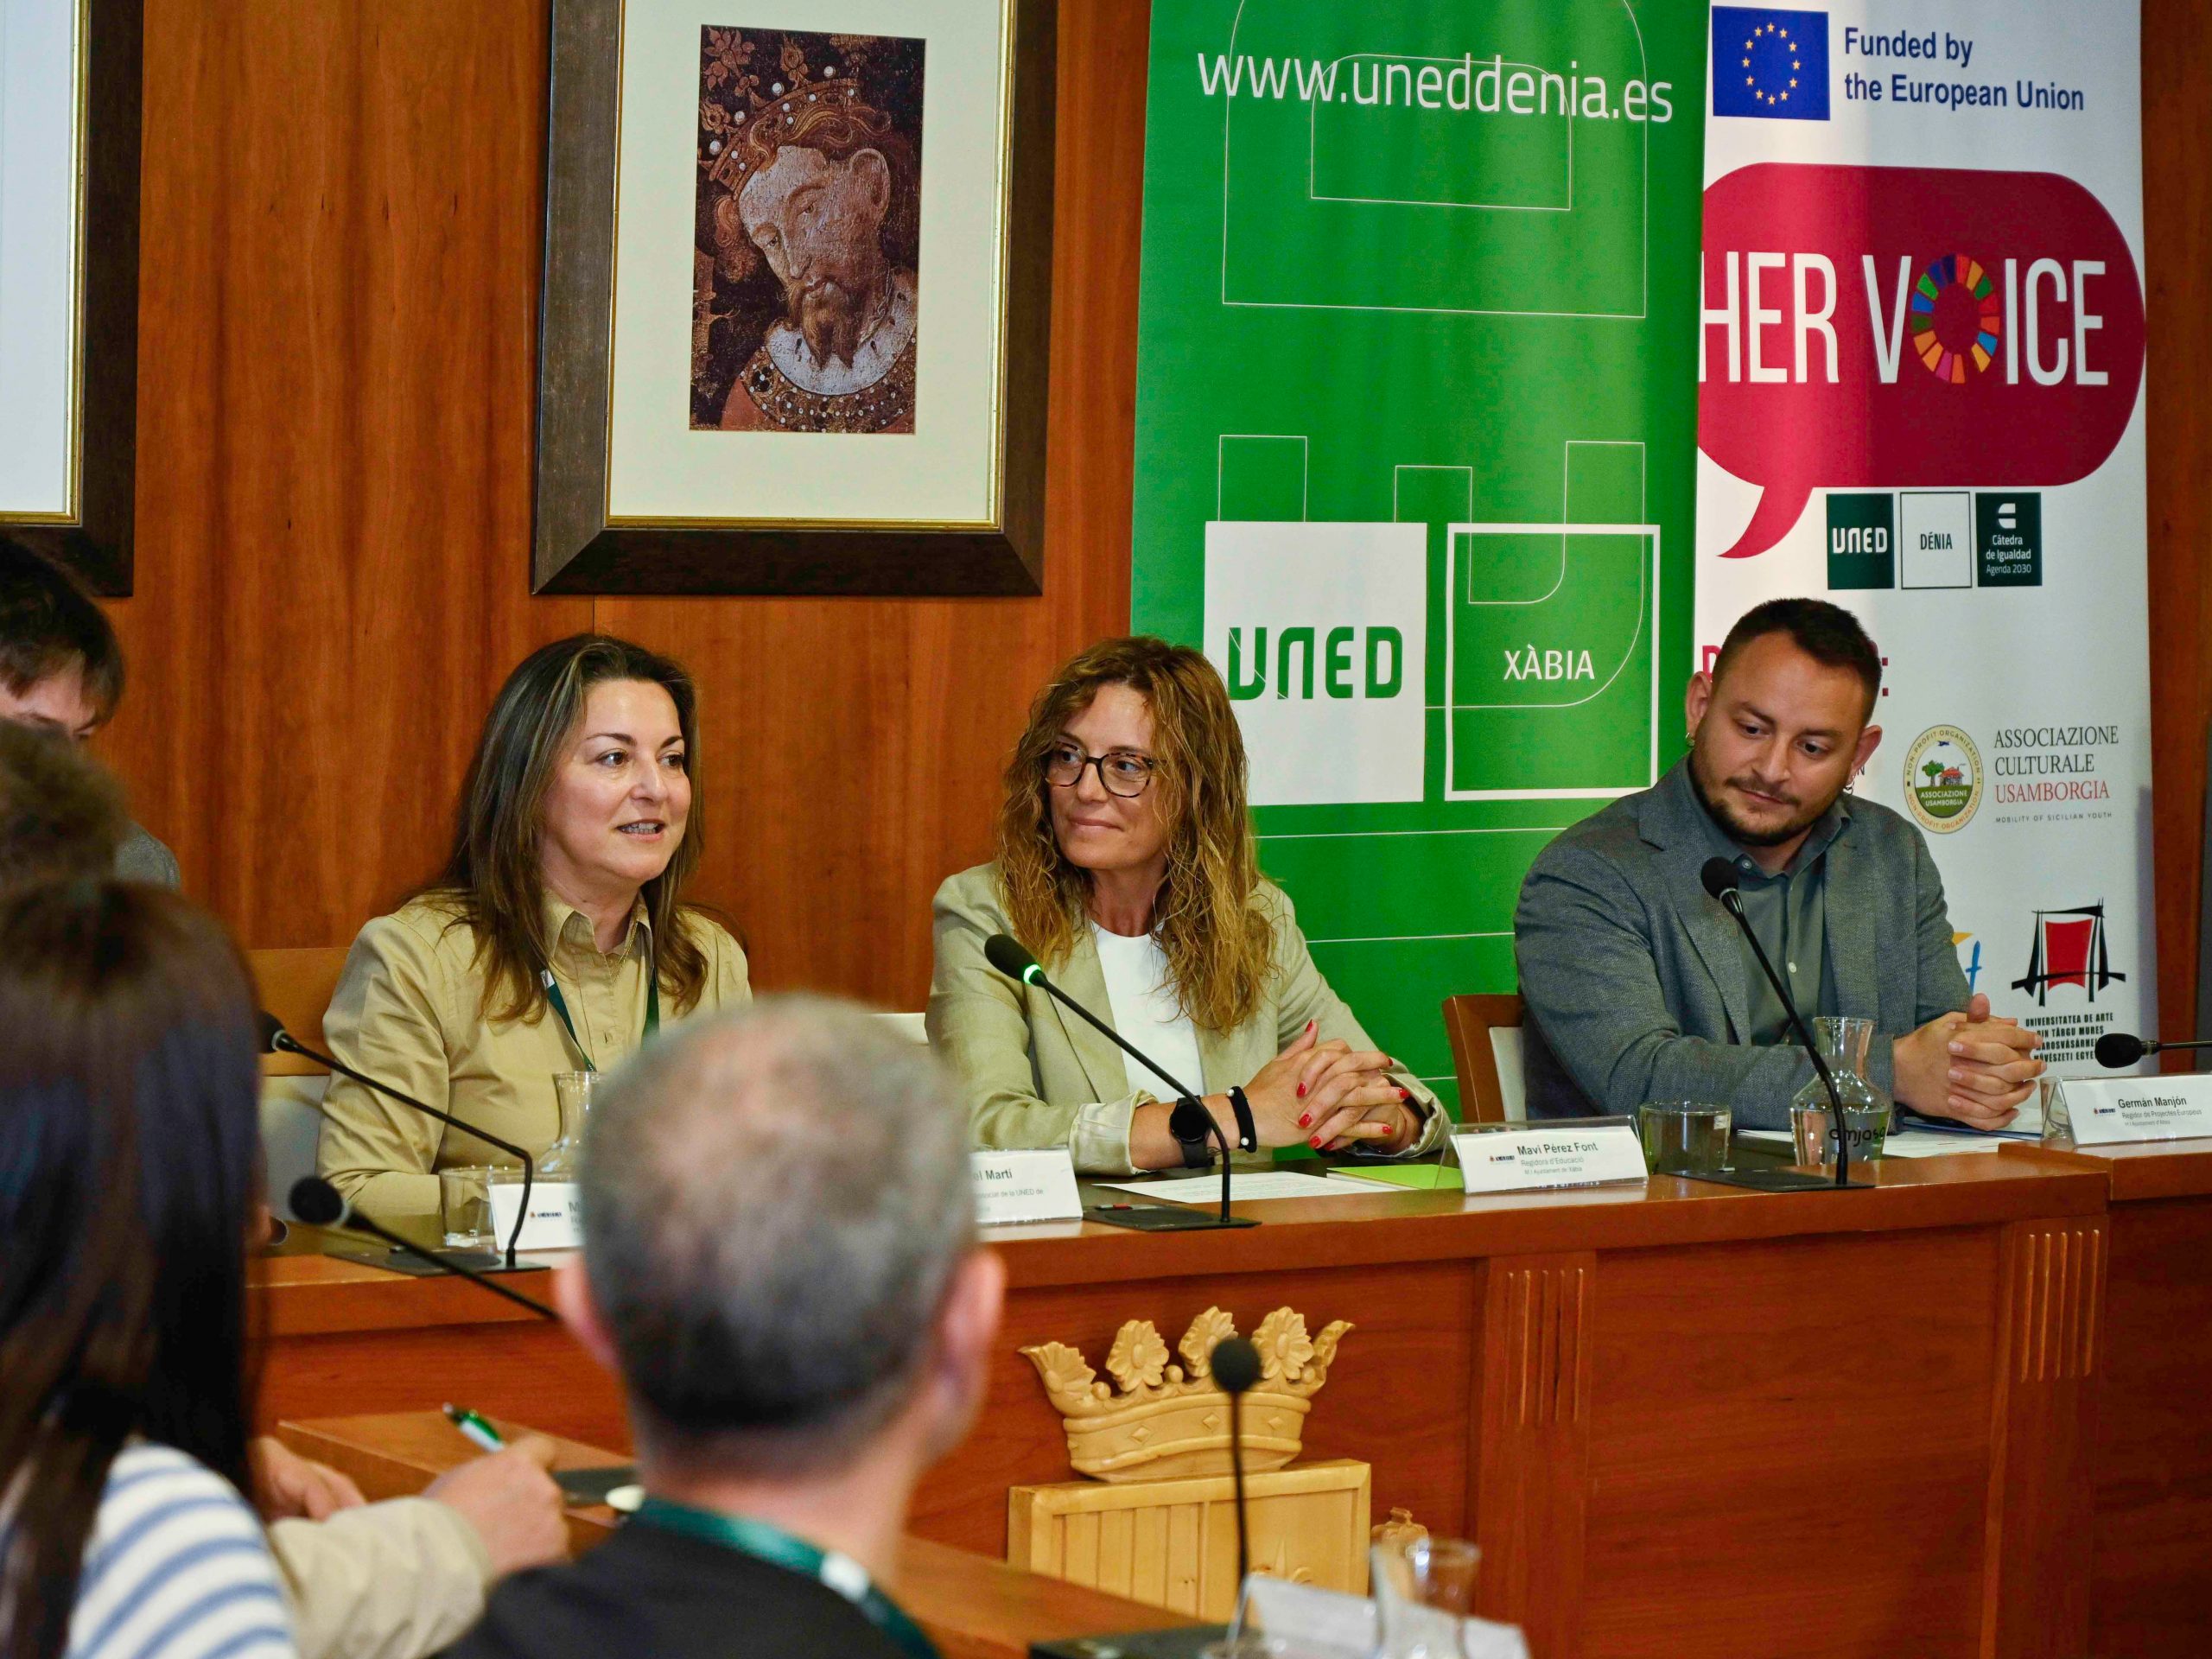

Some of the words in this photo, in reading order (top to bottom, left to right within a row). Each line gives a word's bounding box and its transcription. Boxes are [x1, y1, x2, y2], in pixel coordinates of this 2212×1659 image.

[1845, 27, 1937, 59] Funded
[1945, 33, 1973, 67] by
[1198, 52, 1673, 123] www.uneddenia.es
[1844, 73, 1883, 100] the
[1891, 74, 2007, 111] European
[2017, 81, 2084, 111] Union
[1699, 251, 1840, 383] HER
[1832, 527, 1888, 554] UNED
[1920, 531, 1953, 550] DÉNIA
[1992, 534, 2024, 546] Cátedra
[1986, 550, 1996, 560] de
[1997, 549, 2031, 563] Igualdad
[1986, 564, 2012, 576] Agenda
[2012, 564, 2031, 574] 2030
[1228, 626, 1403, 701] UNED
[1503, 643, 1595, 680] XÀBIA
[1993, 725, 2120, 748] ASSOCIAZIONE
[1994, 753, 2095, 776] CULTURALE
[1920, 790, 1967, 799] ASSOCIAZIONE
[1995, 780, 2111, 804] USAMBORGIA
[1995, 815, 2030, 823] MOBILITY
[2025, 1014, 2082, 1027] UNIVERSITATEA
[2084, 1014, 2093, 1023] DE
[2095, 1012, 2113, 1021] ARTE
[2118, 1098, 2153, 1109] Germán
[2154, 1096, 2187, 1108] Manjón
[1517, 1145, 1541, 1156] Mavi
[1543, 1143, 1573, 1154] Pérez
[1573, 1141, 1599, 1152] Font
